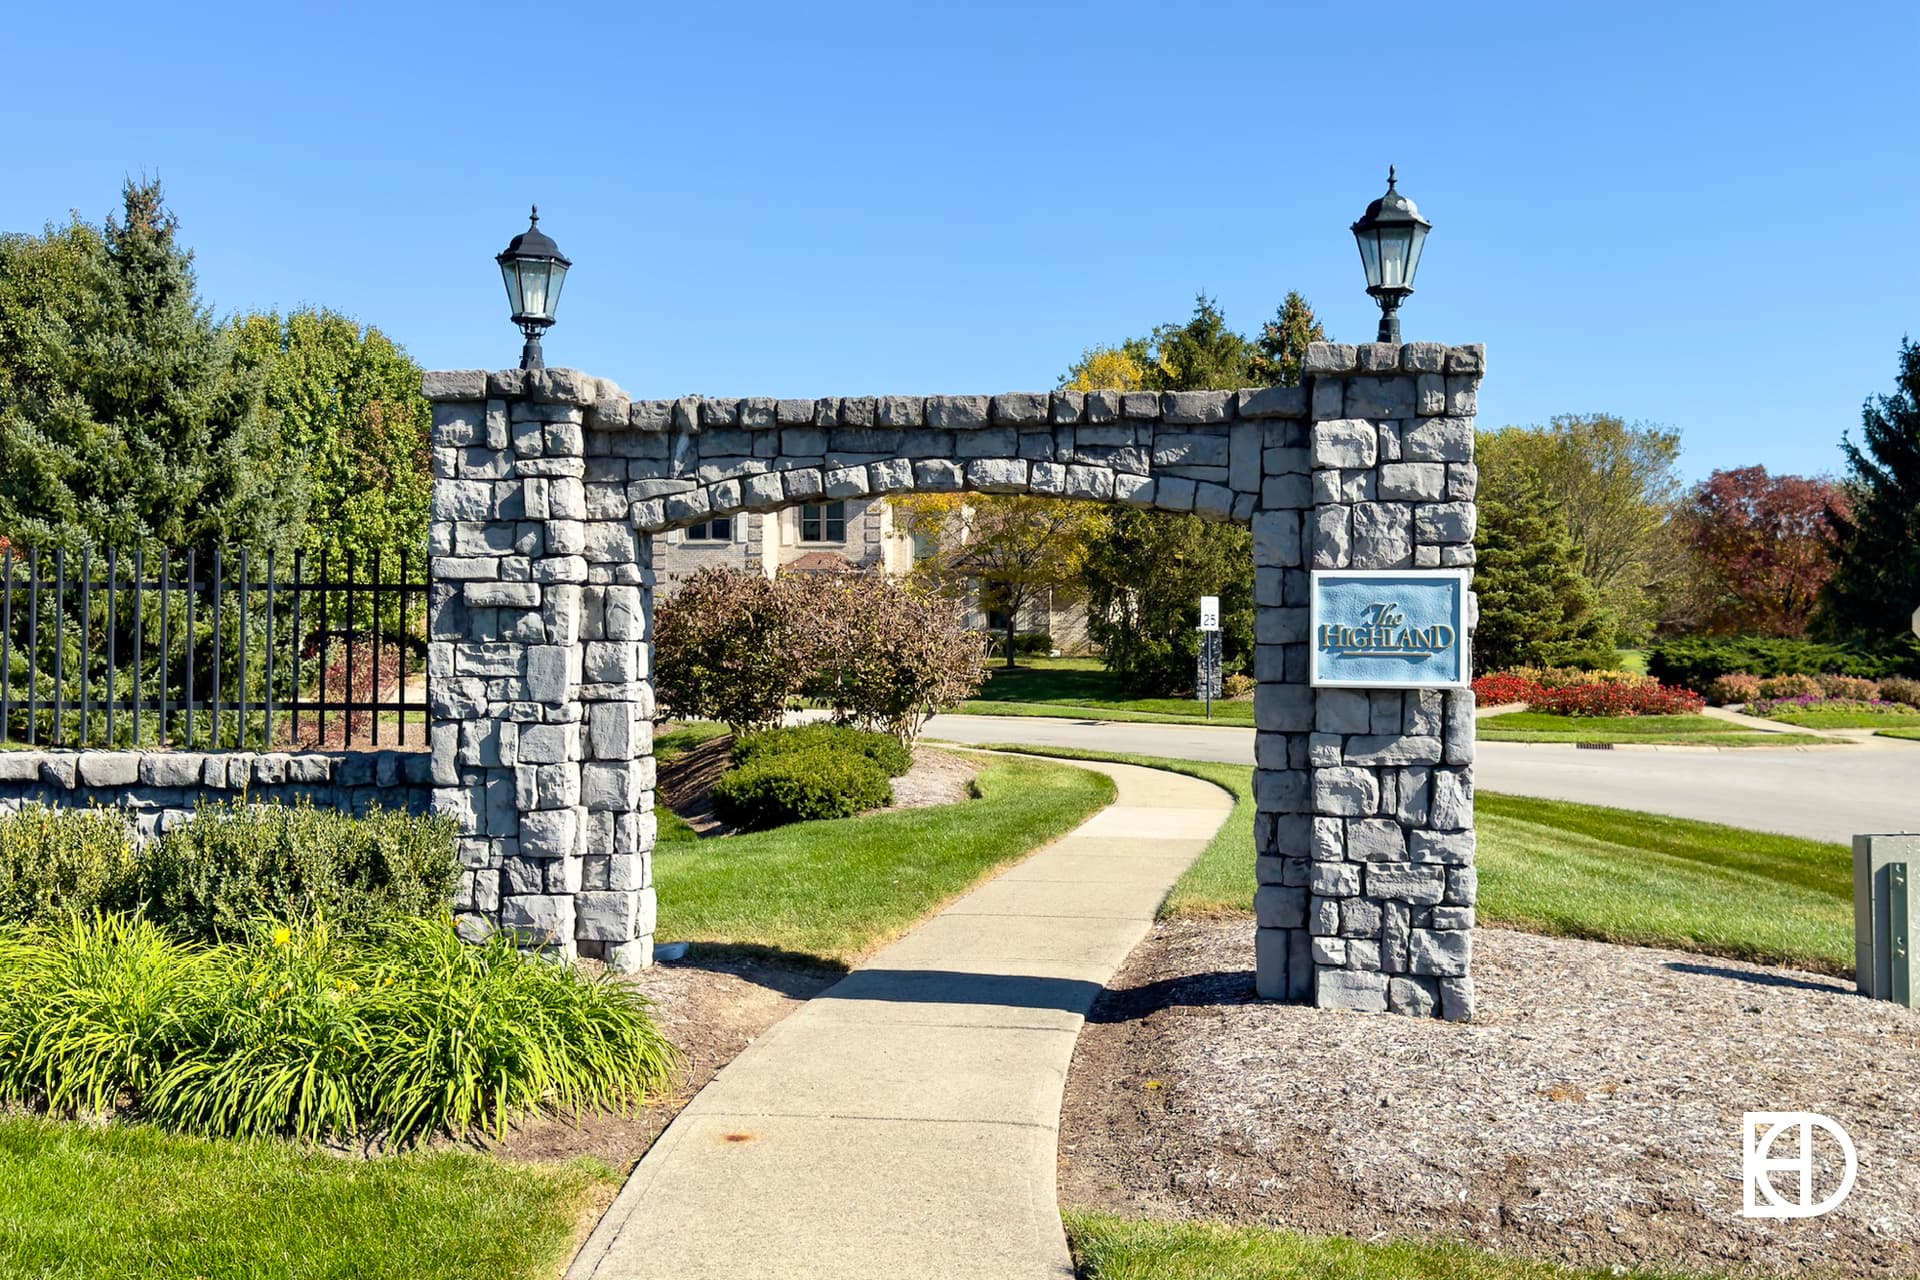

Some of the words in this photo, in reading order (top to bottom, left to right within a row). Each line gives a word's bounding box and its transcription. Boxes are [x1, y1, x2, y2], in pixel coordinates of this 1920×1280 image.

[1203, 614, 1217, 626] 25
[1360, 601, 1404, 626] The
[1320, 624, 1455, 649] HIGHLAND
